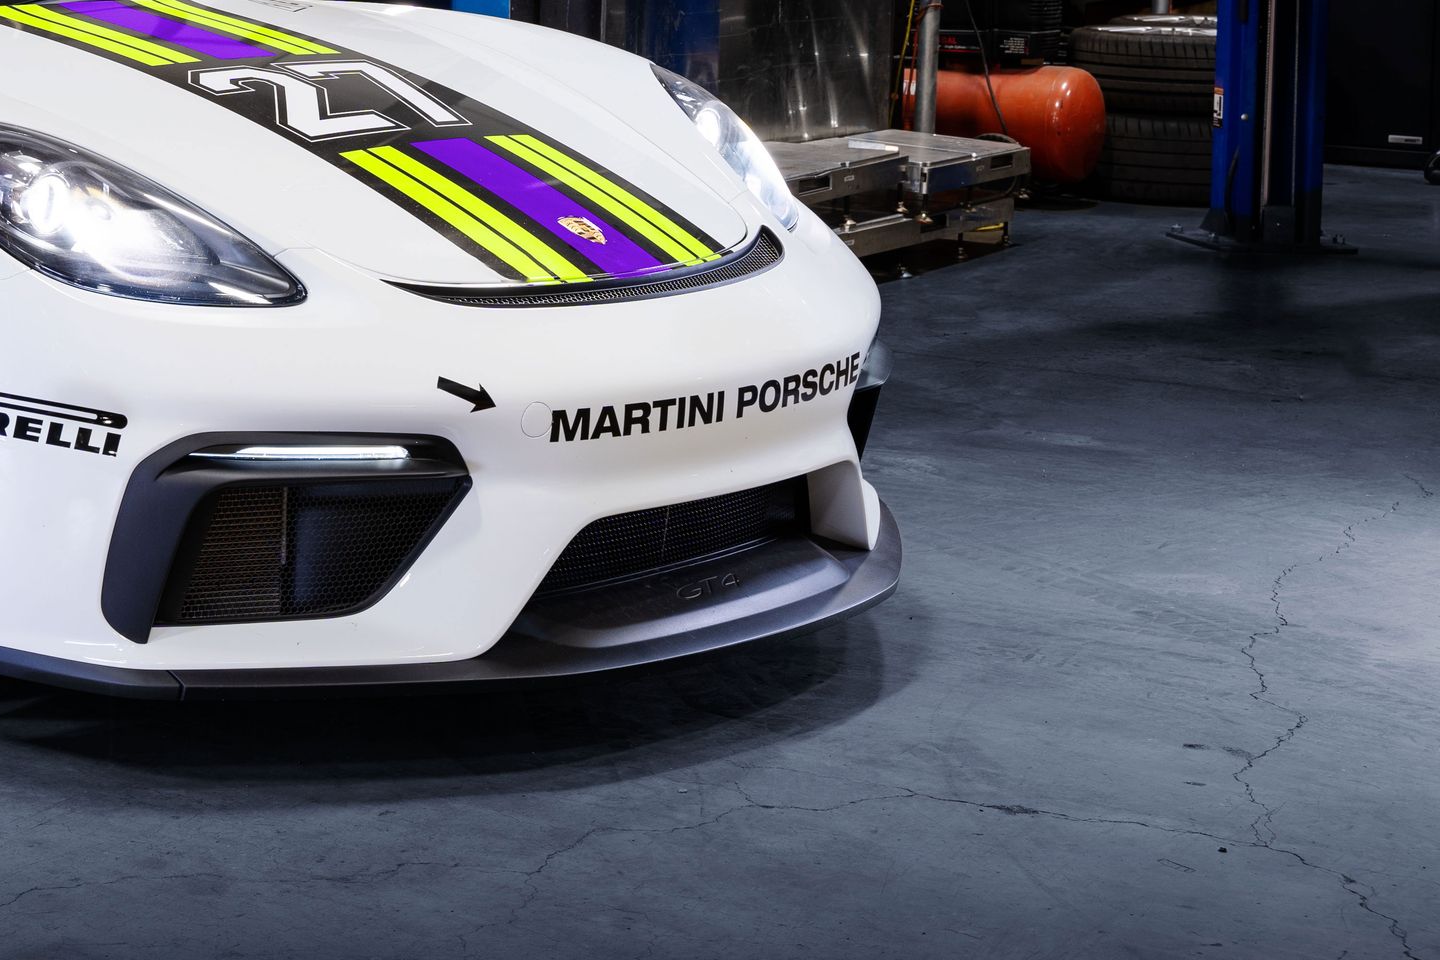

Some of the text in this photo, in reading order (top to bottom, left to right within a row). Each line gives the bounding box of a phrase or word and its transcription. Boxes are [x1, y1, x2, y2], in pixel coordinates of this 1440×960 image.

[188, 59, 473, 143] 27
[549, 351, 860, 443] MARTINI PORSCHE
[676, 573, 740, 600] GT4
